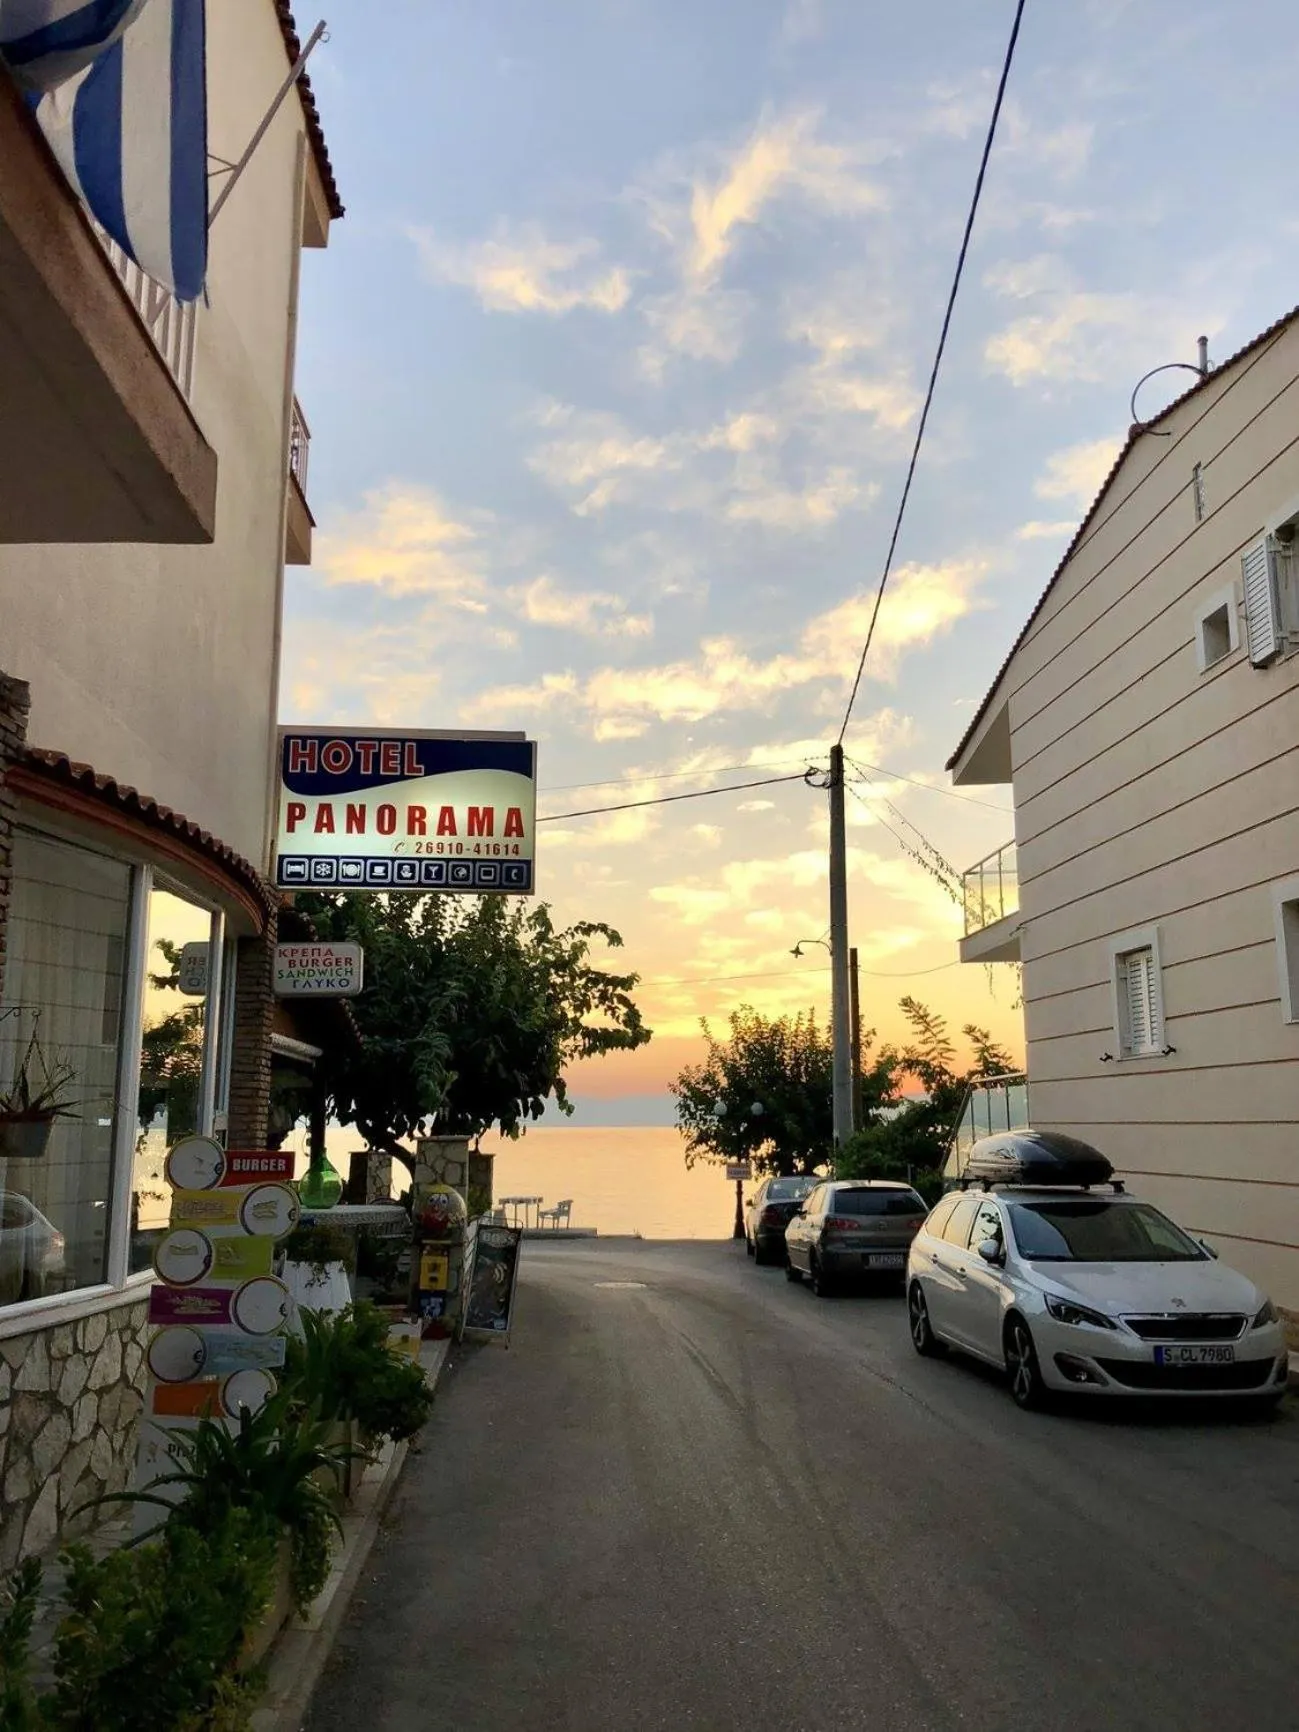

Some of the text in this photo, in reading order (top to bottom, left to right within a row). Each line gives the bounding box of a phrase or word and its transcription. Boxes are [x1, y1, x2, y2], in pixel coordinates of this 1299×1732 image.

[288, 739, 425, 776] HOTEL
[286, 802, 525, 838] PANORAMA
[415, 841, 520, 856] 26910-41614
[288, 957, 353, 969] BURGER
[277, 967, 354, 979] SANDWICH
[292, 978, 350, 989] ΓΛΥΚΟ
[232, 1158, 287, 1172] BURGER
[1164, 1348, 1172, 1362] S
[1180, 1348, 1198, 1362] CL
